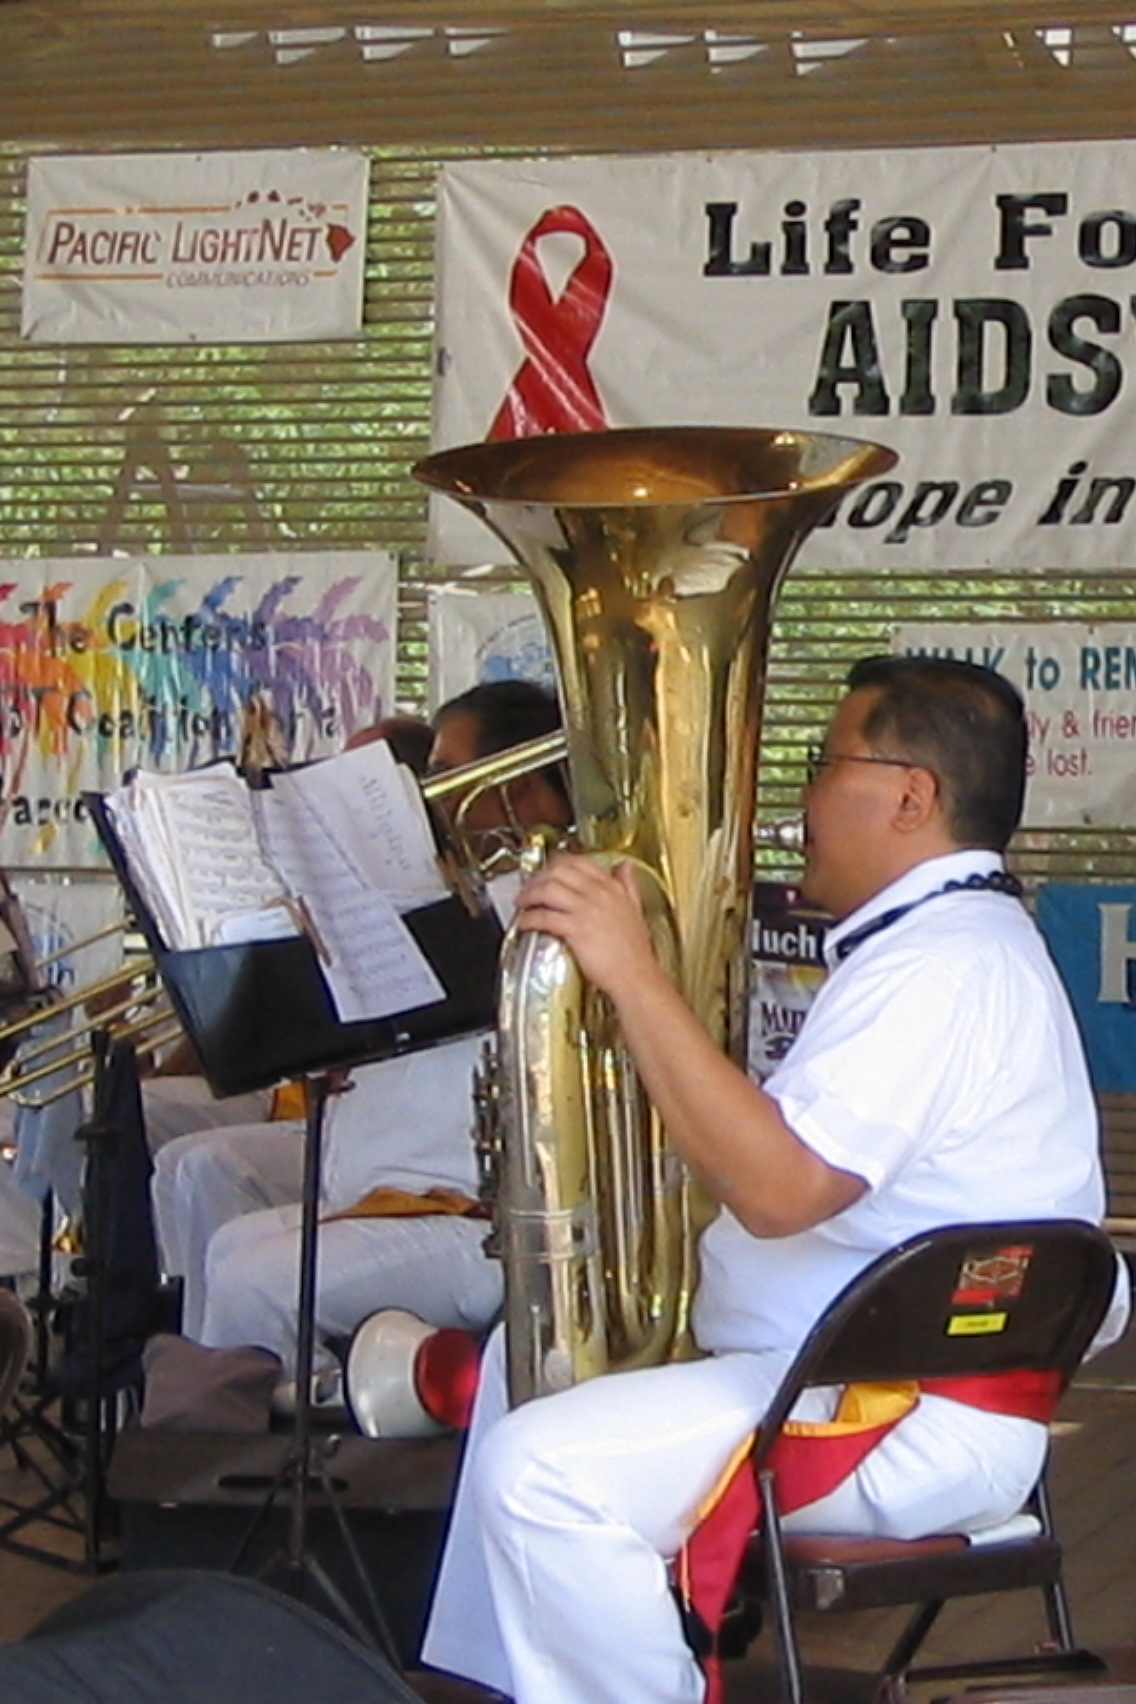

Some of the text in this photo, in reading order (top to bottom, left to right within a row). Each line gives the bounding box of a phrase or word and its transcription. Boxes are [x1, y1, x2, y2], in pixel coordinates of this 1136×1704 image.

[704, 199, 931, 276] Life
[815, 479, 1013, 543] ope
[1038, 460, 1136, 525] in
[19, 601, 88, 655] The
[1026, 647, 1060, 691] to
[1062, 709, 1081, 739] &
[1047, 749, 1093, 777] lost.
